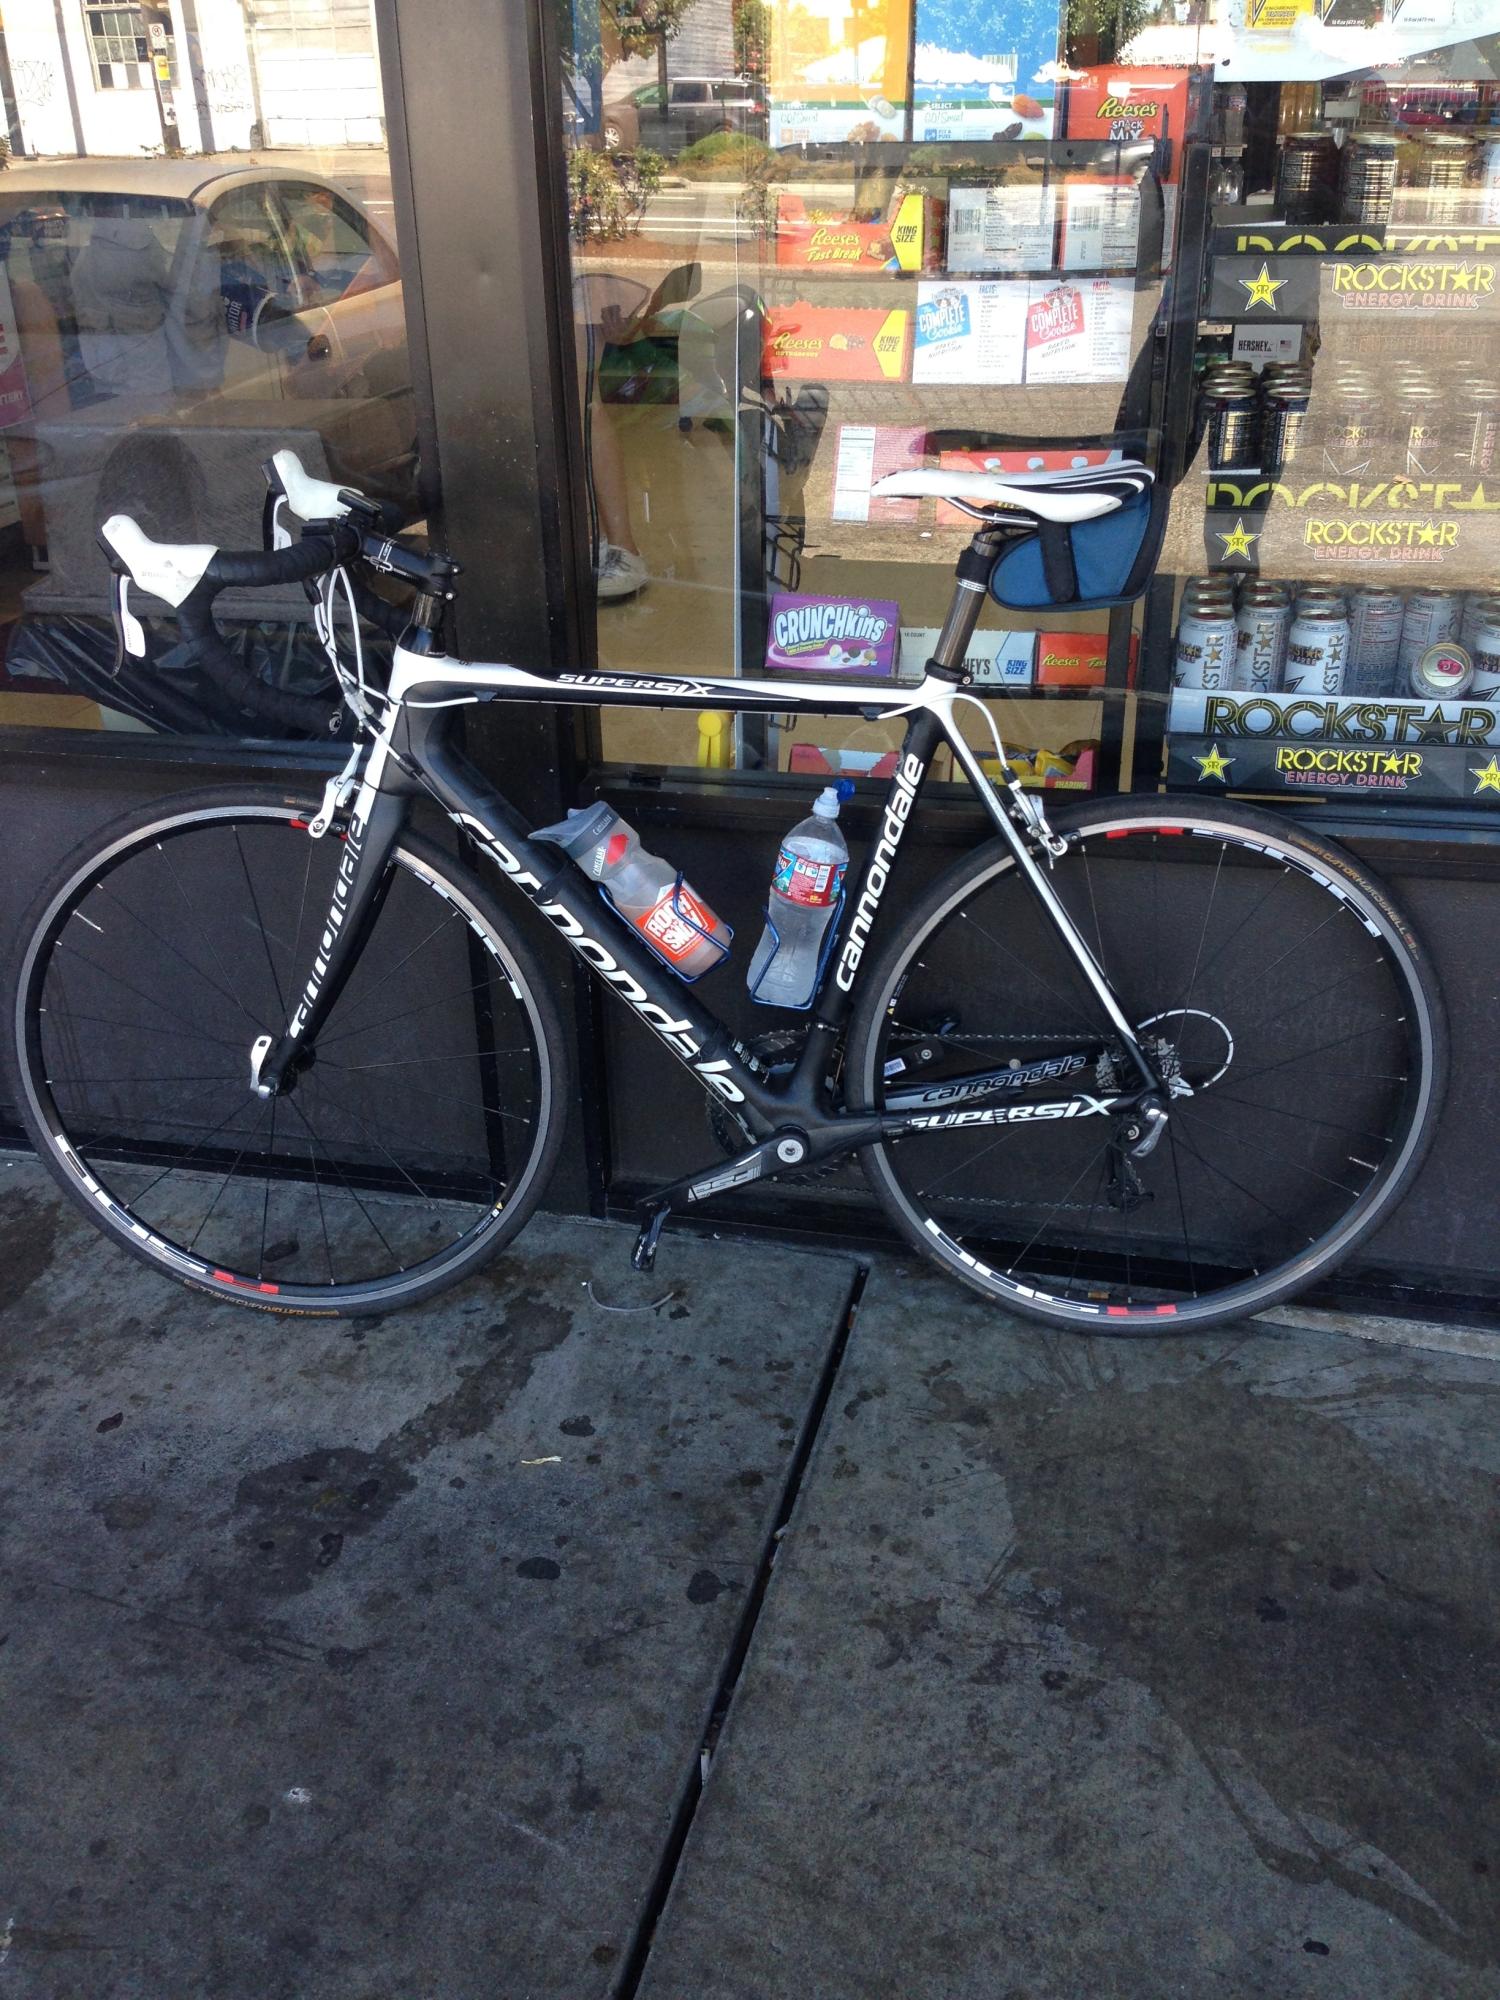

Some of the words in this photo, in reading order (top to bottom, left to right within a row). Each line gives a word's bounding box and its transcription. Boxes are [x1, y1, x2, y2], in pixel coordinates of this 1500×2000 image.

[1097, 97, 1158, 118] Reese's
[897, 225, 918, 235] KING
[895, 234, 916, 243] SIZE
[802, 246, 831, 262] Fast
[832, 247, 863, 261] Break
[1344, 292, 1413, 307] ENERGY
[1422, 292, 1478, 307] DRINK
[919, 304, 966, 333] COMPLETE
[1031, 303, 1079, 333] COMPLETE
[879, 335, 900, 344] KING
[877, 343, 898, 353] SIZE
[1480, 422, 1497, 475] ENERGY
[1316, 547, 1380, 560] ENERGY
[1390, 548, 1444, 561] DRINK
[1007, 660, 1028, 668] KING
[1042, 654, 1080, 666] Reese's
[1005, 667, 1026, 675] SIZE
[556, 674, 716, 696] SUPERSIX
[1285, 771, 1350, 784] ENERGY
[1356, 774, 1406, 787] DRINK
[836, 753, 925, 993] cannondale
[922, 1055, 1087, 1103] cannondale
[910, 1094, 1119, 1129] SUPERSIX
